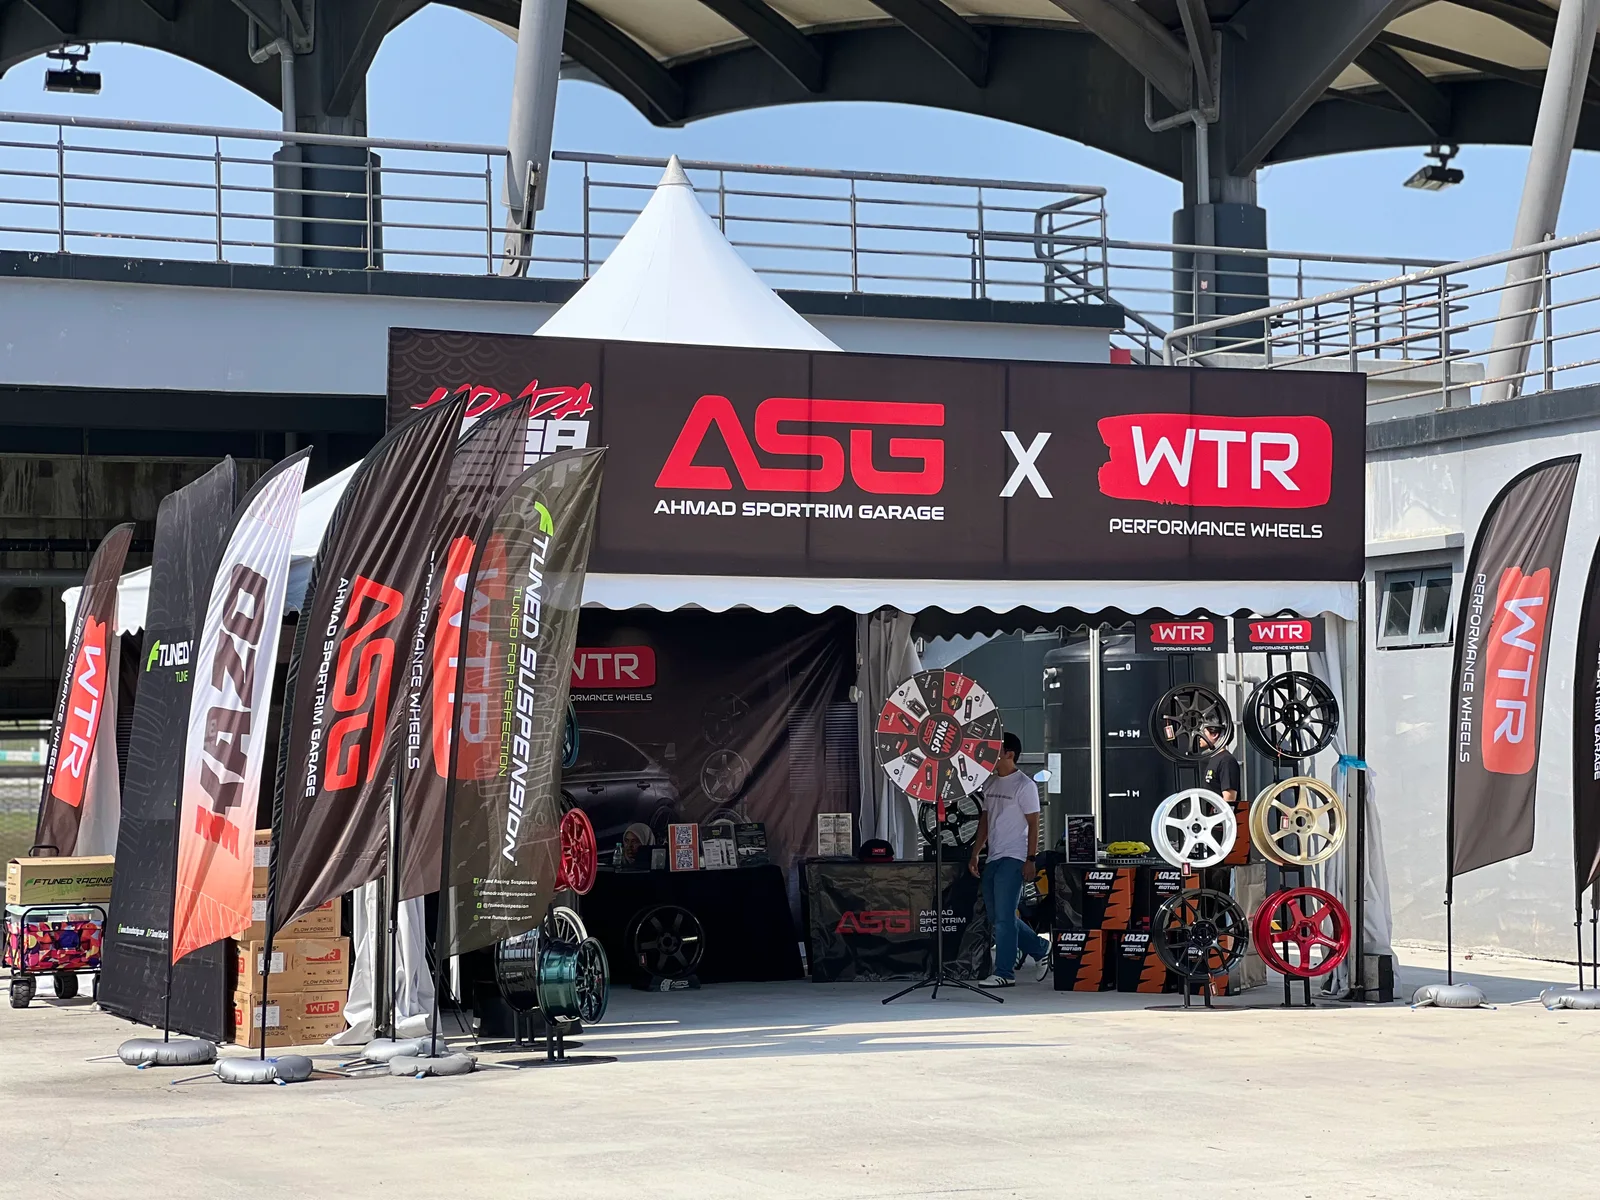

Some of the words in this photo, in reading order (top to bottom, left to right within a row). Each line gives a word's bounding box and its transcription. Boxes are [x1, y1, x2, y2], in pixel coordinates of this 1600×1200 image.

[654, 395, 945, 495] ASG
[999, 431, 1053, 498] X
[1131, 426, 1300, 491] WTR
[654, 500, 736, 516] AHMAD
[742, 502, 853, 519] SPORTRIM
[859, 505, 944, 521] GARAGE
[1109, 518, 1246, 537] PERFORMANCE
[1250, 523, 1323, 539] WHEELS
[326, 577, 349, 636] AHMAD
[509, 585, 522, 638] TUNED
[1159, 625, 1205, 640] WTR
[1257, 624, 1303, 639] WTR
[1463, 572, 1487, 692] PERFORMANCE
[313, 640, 335, 726] SPORTRIM
[323, 574, 404, 792] ASG
[507, 642, 517, 676] FOR
[1493, 596, 1544, 745] WTR
[59, 645, 101, 779] WTR
[616, 693, 652, 701] WHEELS
[46, 726, 62, 784] WHEELS
[407, 692, 421, 770] WHEELS
[499, 679, 514, 777] PERFECTION
[502, 643, 538, 862] SUSPENSION
[922, 719, 936, 745] ASG
[941, 725, 958, 754] WIN!
[1459, 697, 1474, 764] WHEELS
[305, 729, 321, 798] GARAGE
[1085, 871, 1113, 880] KAZO
[835, 910, 911, 934] ASG
[1057, 933, 1086, 942] KAZO
[1121, 933, 1149, 942] KAZO
[310, 1003, 335, 1013] WTR
